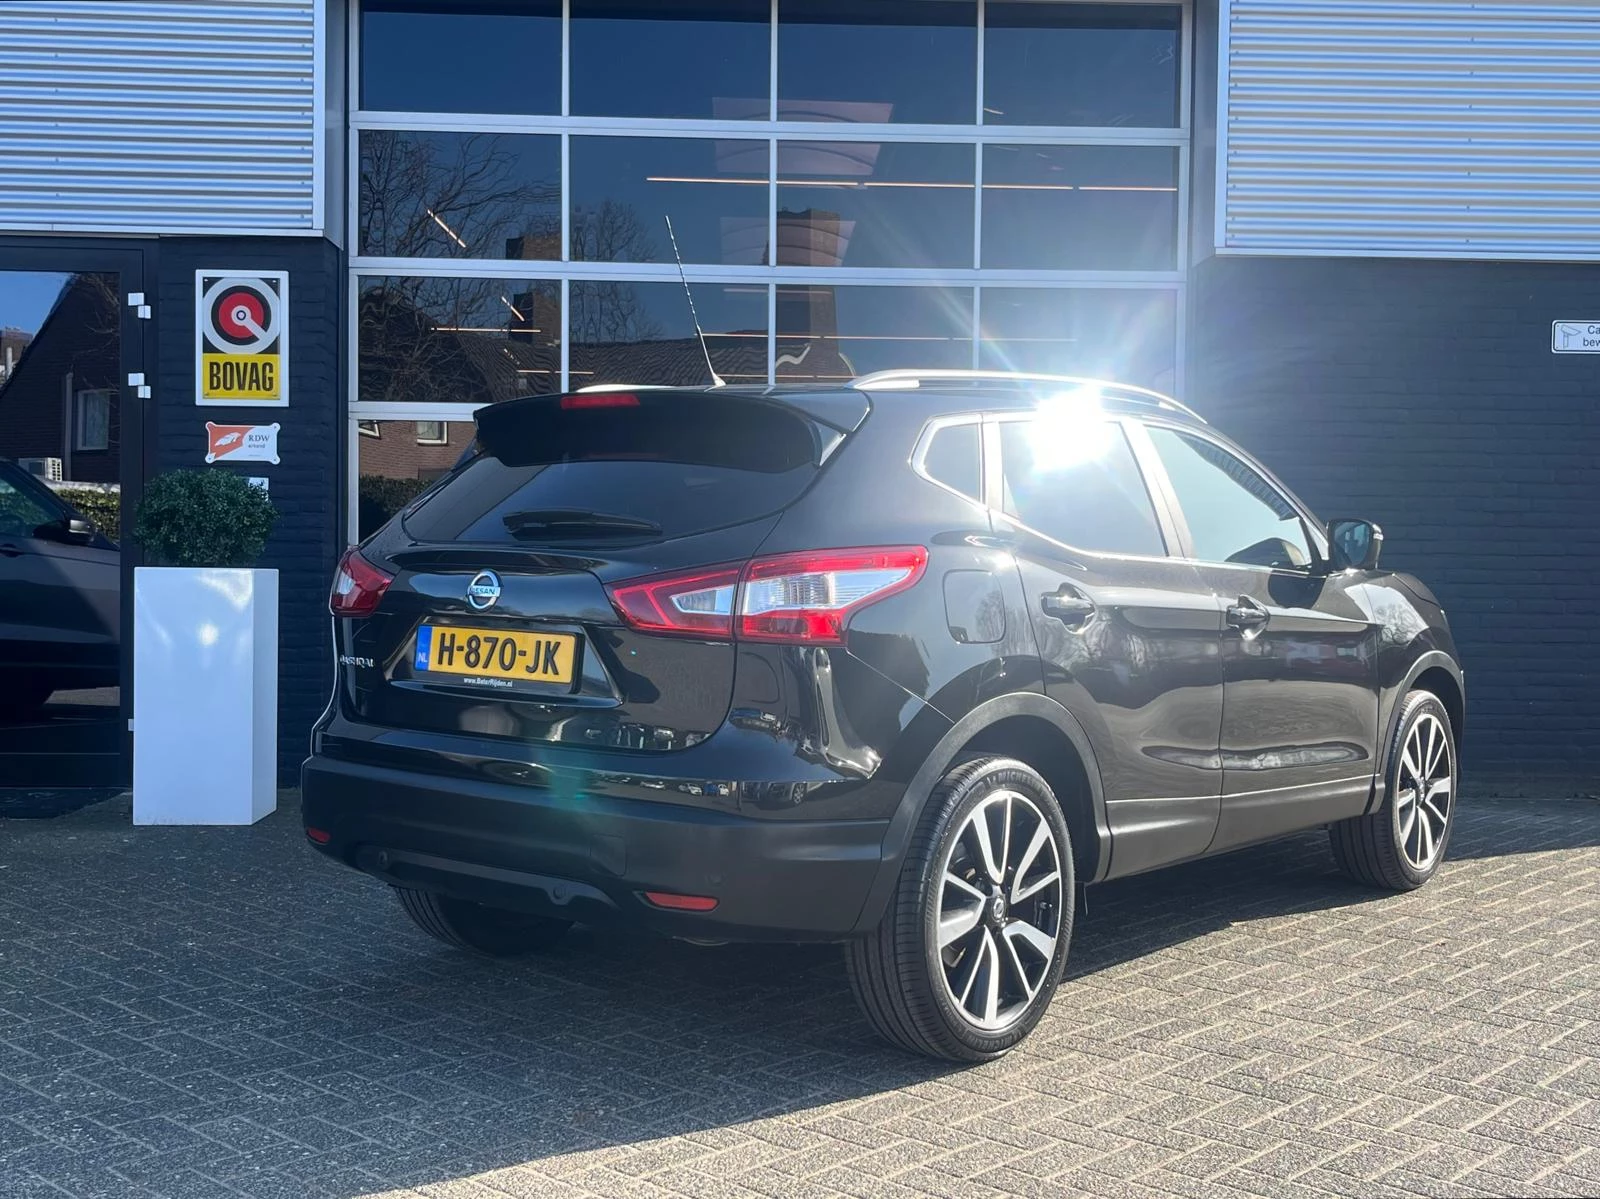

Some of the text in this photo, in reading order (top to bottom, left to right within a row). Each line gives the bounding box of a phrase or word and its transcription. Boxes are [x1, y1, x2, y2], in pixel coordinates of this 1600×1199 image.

[209, 361, 274, 392] BOVAG
[248, 434, 270, 442] RDW
[417, 652, 428, 663] NL
[437, 632, 561, 676] H-870-JK
